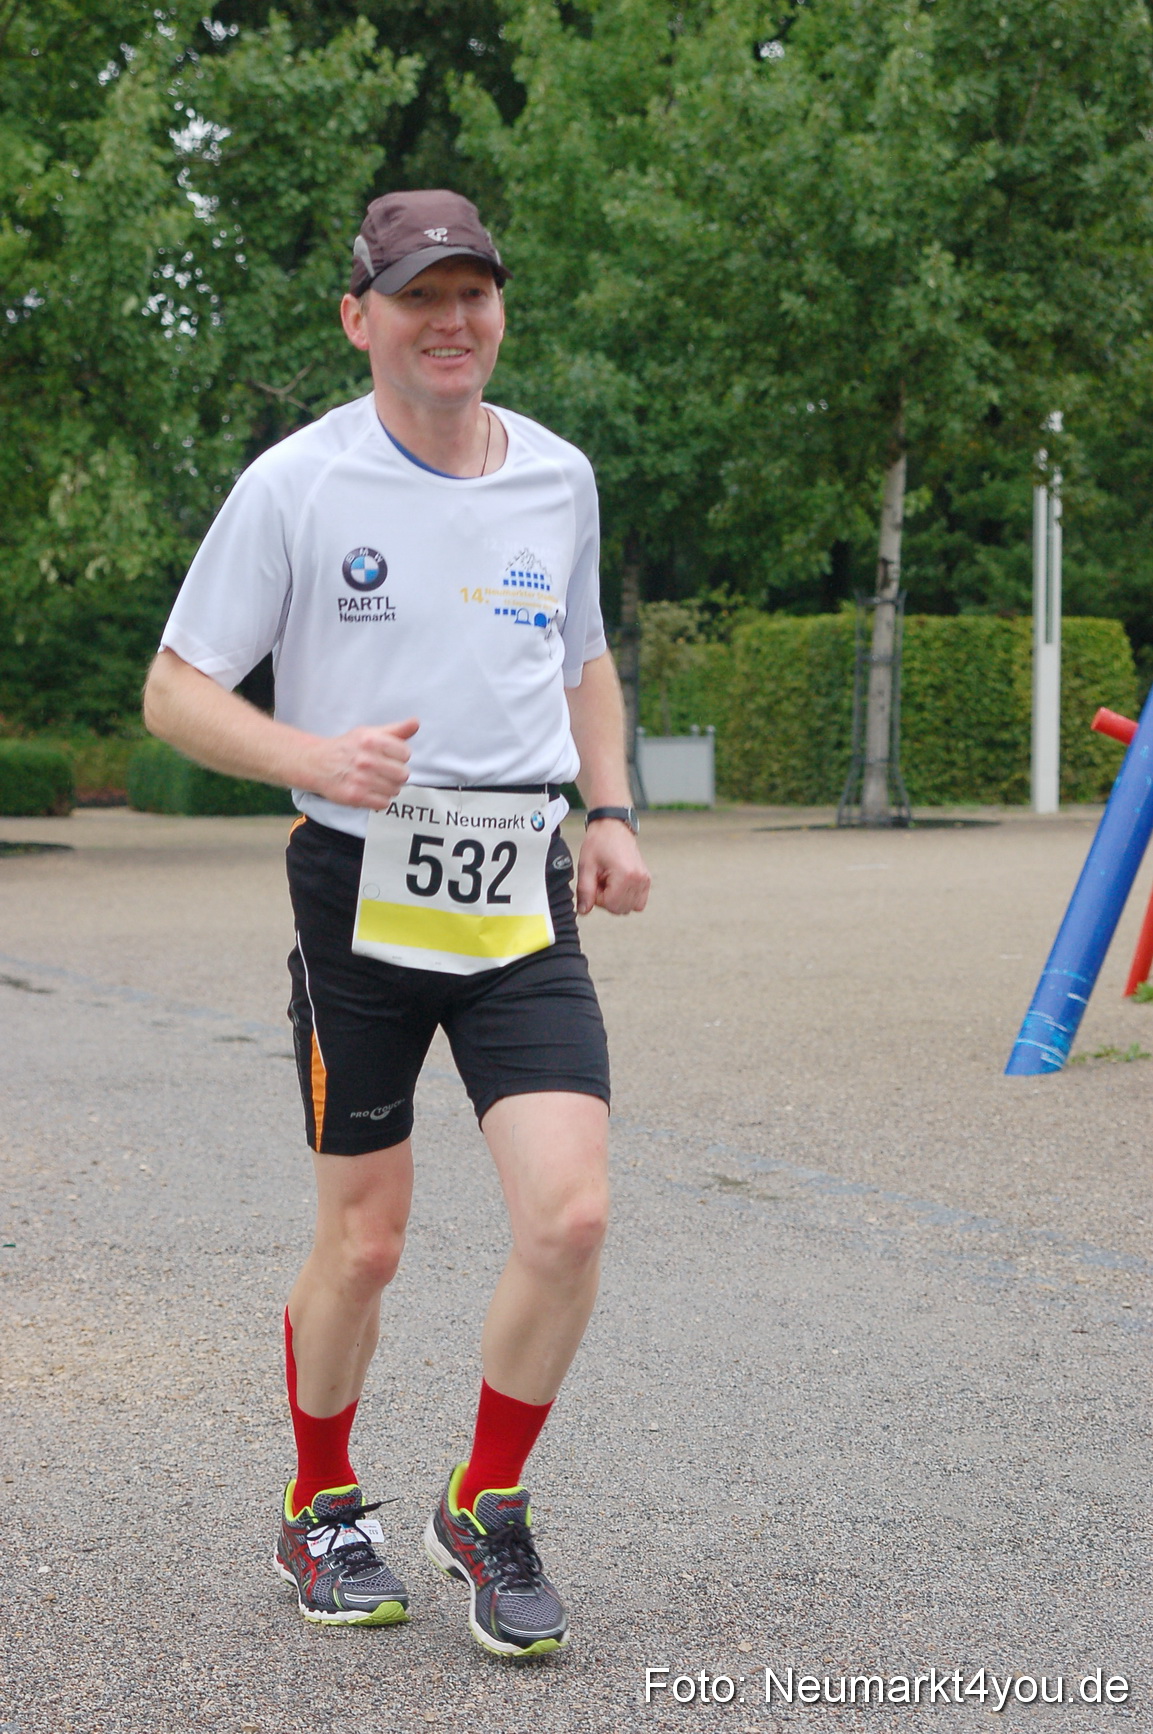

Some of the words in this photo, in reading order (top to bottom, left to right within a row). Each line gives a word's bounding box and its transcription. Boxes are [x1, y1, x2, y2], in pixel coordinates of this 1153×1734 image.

[460, 586, 490, 604] 14.
[337, 596, 396, 611] PARTL
[339, 611, 396, 622] Neumarkt
[375, 802, 440, 825] ARTL
[446, 811, 525, 830] Neumarkt
[405, 833, 518, 905] 532
[350, 1110, 369, 1118] PRO
